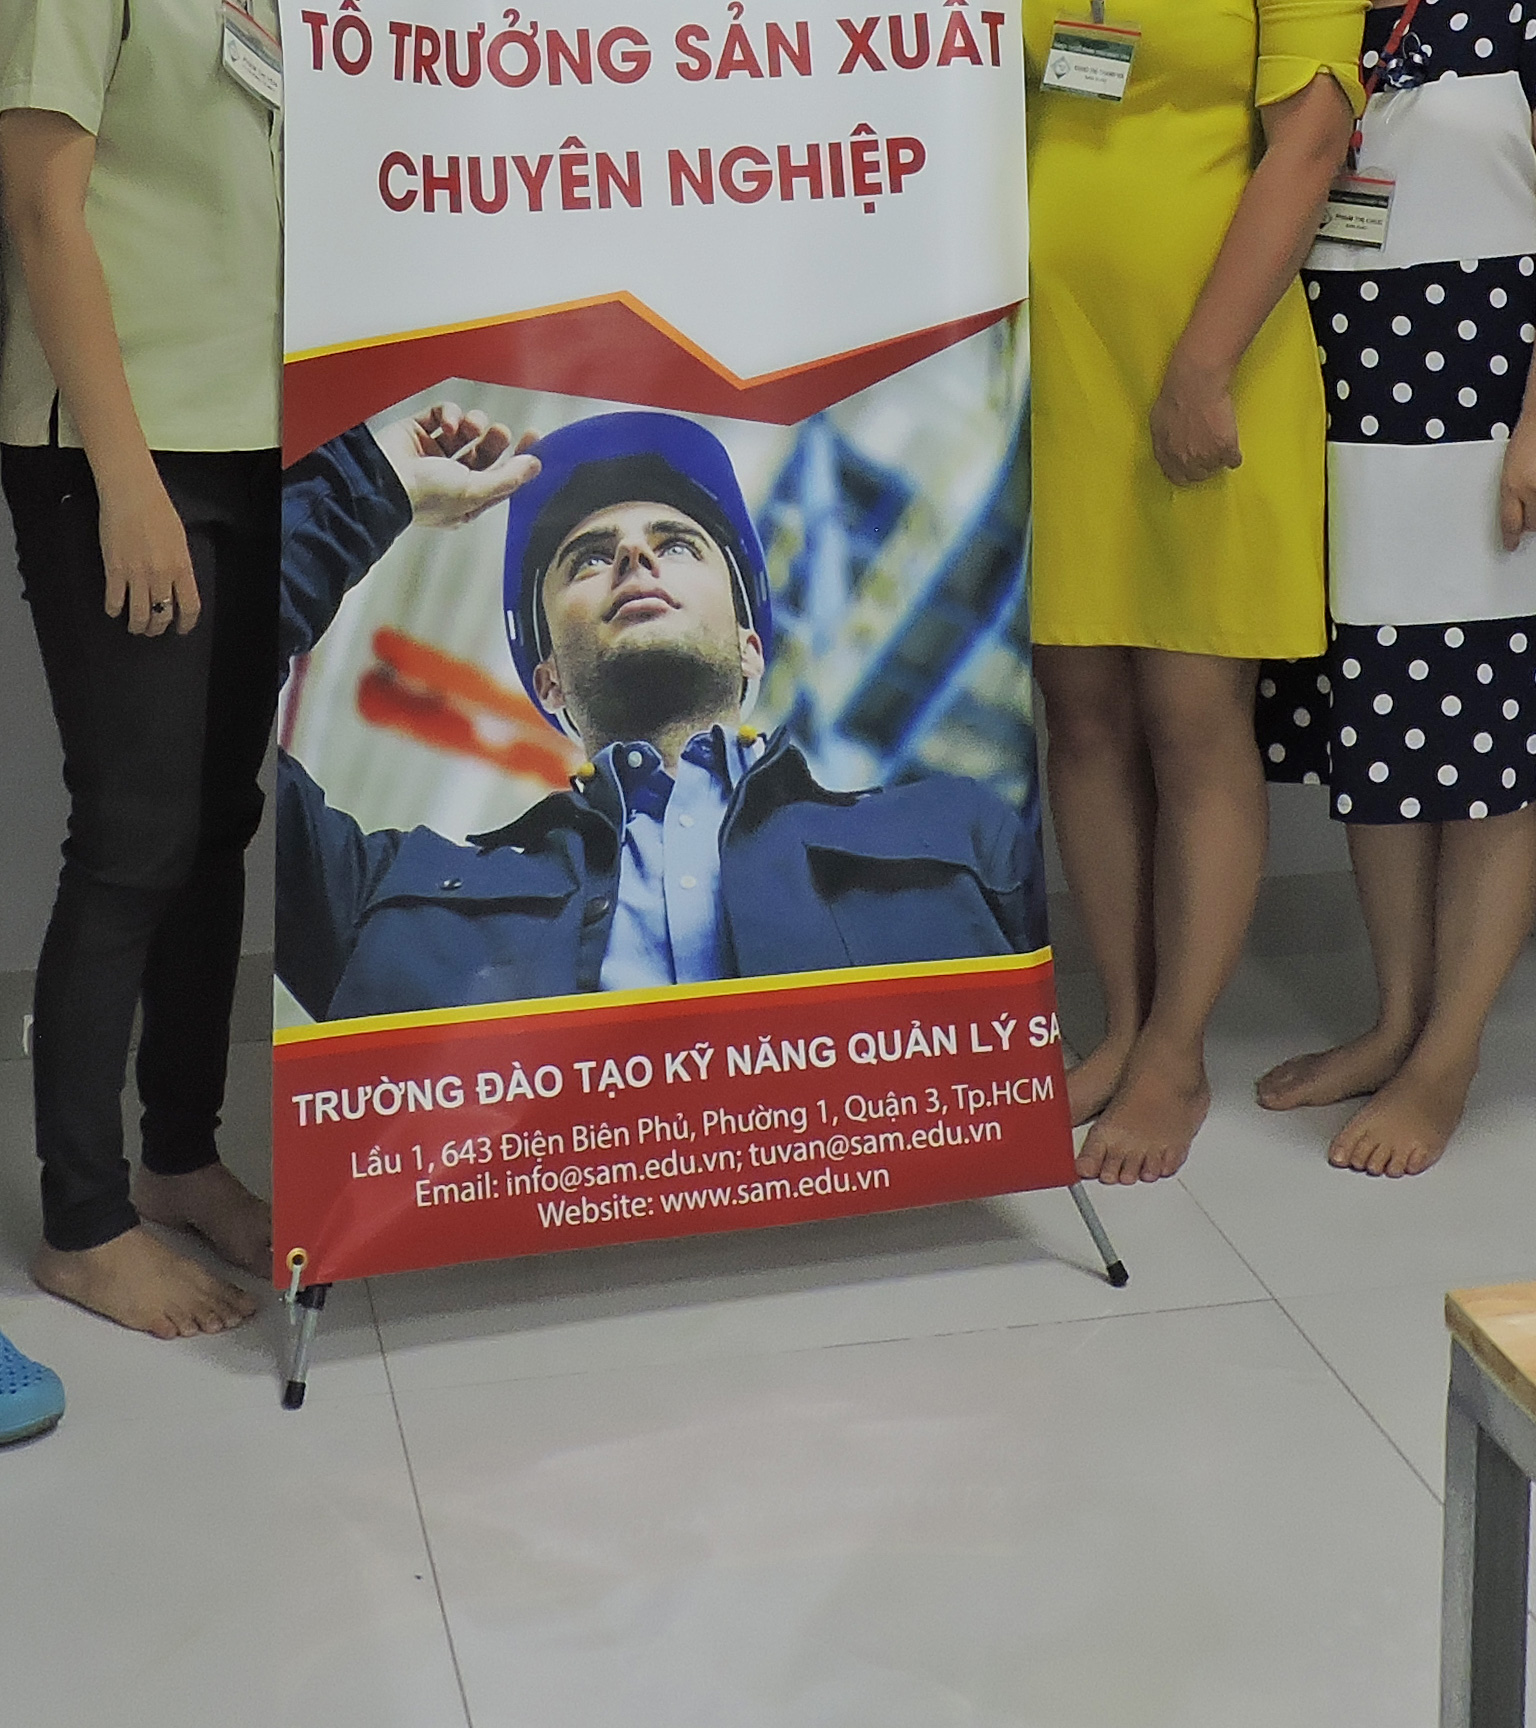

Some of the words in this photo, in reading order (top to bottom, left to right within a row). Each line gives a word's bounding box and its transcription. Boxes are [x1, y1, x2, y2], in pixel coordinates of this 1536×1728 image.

[388, 8, 652, 89] TRƯỞNG
[675, 1, 812, 82] SẢN
[377, 135, 643, 214] CHUYÊN
[669, 122, 927, 214] NGHIỆP
[291, 1076, 465, 1128] TRƯỜNG
[476, 1060, 563, 1106] ĐÀO
[573, 1054, 654, 1099] TẠO
[665, 1041, 715, 1084] KỸ
[727, 1034, 837, 1078] NĂNG
[847, 1020, 957, 1066] QUẢN
[970, 1012, 1018, 1054] LÝ
[351, 1145, 402, 1178] Lầu
[411, 1144, 435, 1174] 1,
[441, 1137, 493, 1168] 643
[501, 1129, 564, 1164] Điện
[572, 1121, 630, 1153] Biên
[638, 1113, 696, 1144] Phủ,
[703, 1104, 808, 1137] Phường
[817, 1100, 838, 1128] 1,
[845, 1090, 917, 1123] Quận
[925, 1088, 949, 1116] 3,
[952, 1075, 1054, 1115] Tp.HCM
[415, 1171, 499, 1208] Email:
[506, 1146, 744, 1199] info@sam.edu.vn;
[749, 1118, 1002, 1168] tuvan@sam.edu.vn
[536, 1193, 654, 1229] Website:
[659, 1165, 891, 1214] www.sam.edu.vn
